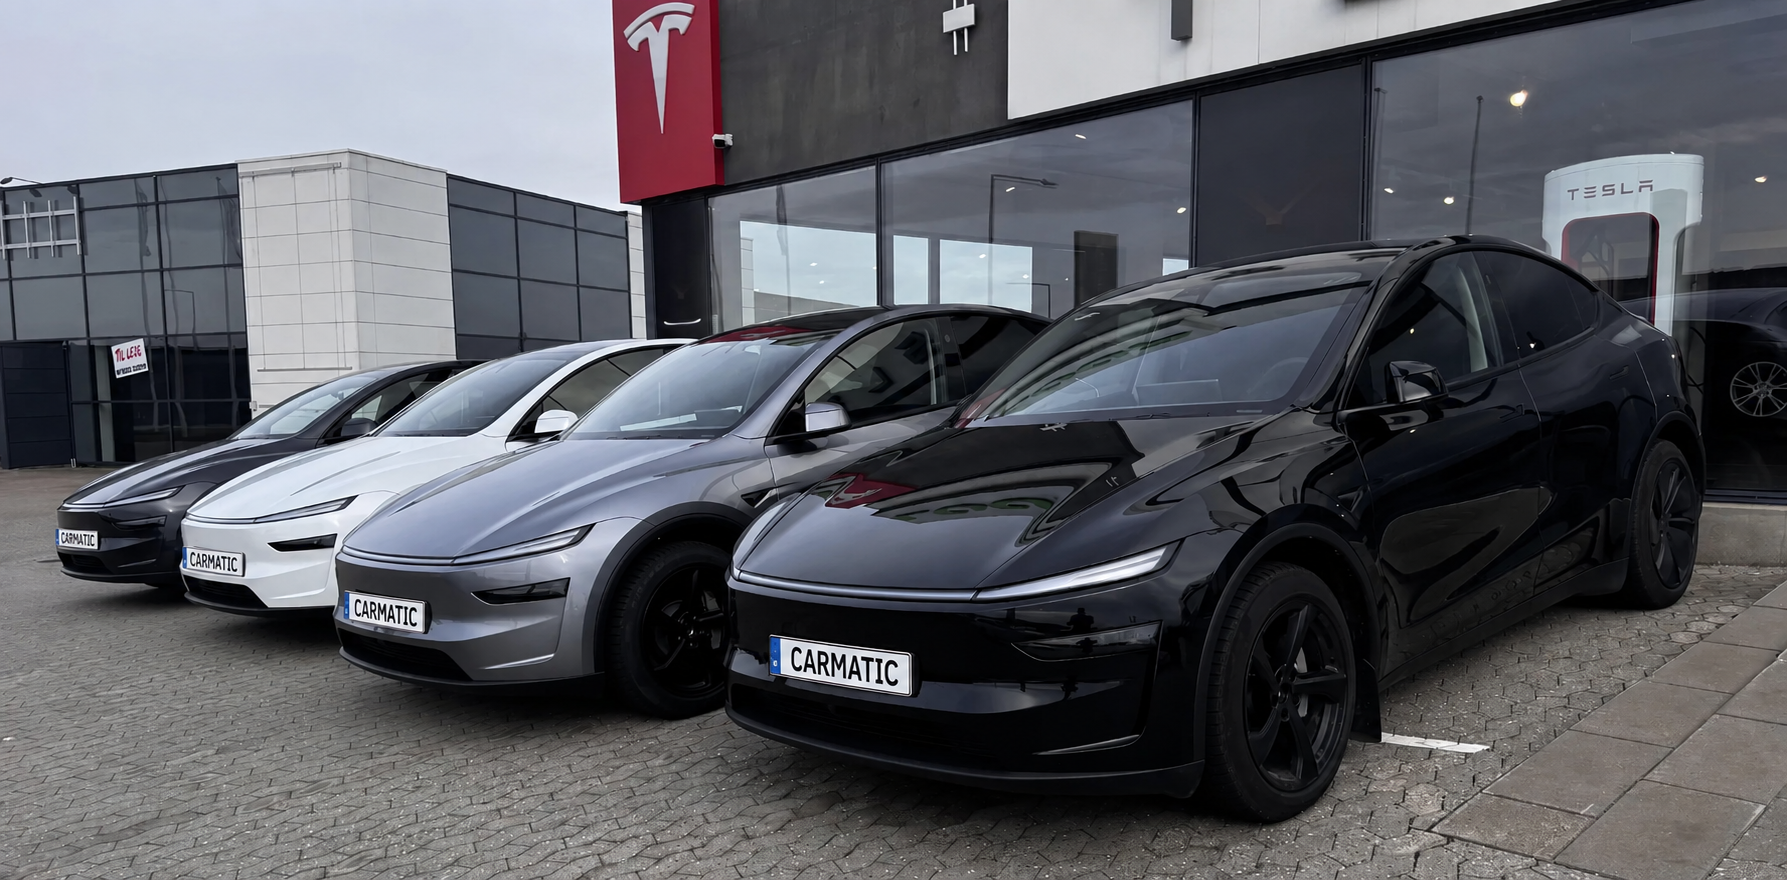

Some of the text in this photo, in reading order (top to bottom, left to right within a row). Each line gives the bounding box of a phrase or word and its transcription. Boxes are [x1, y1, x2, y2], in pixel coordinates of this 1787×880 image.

[1567, 179, 1654, 201] TESLA
[60, 531, 96, 547] CARMATIC
[189, 551, 238, 573] CARMATIC
[354, 598, 418, 627] CARMATIC
[790, 646, 899, 687] CARMATIC
